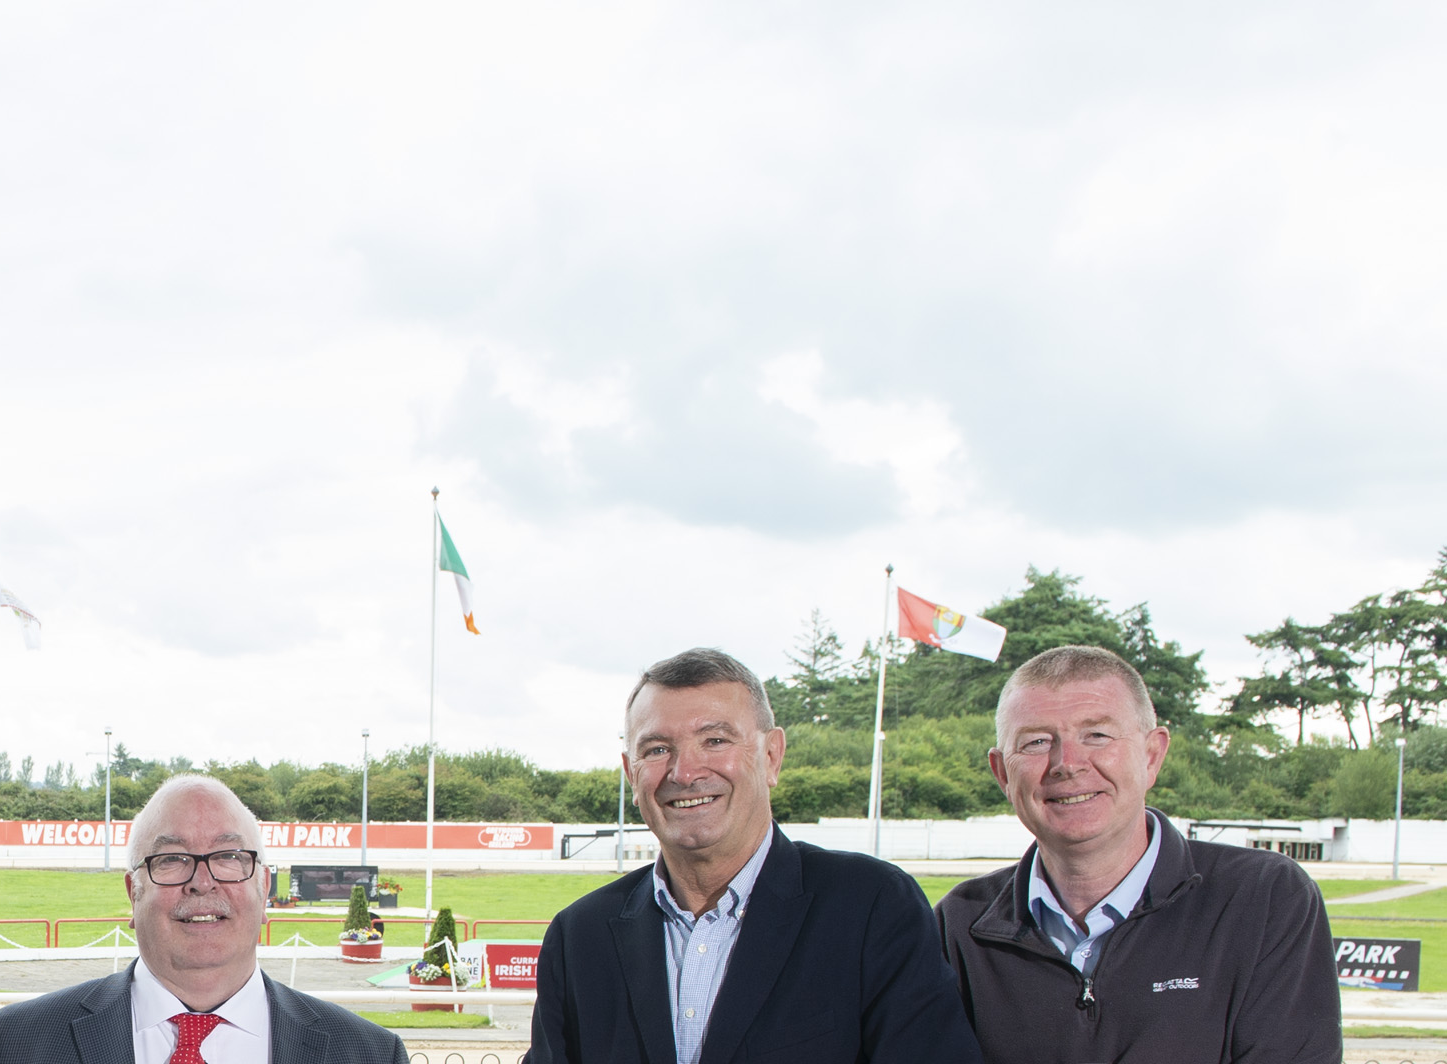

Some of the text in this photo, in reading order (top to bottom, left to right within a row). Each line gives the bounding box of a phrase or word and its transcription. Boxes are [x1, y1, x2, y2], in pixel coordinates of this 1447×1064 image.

[21, 823, 127, 845] WELCOME
[293, 825, 353, 847] PARK
[510, 956, 538, 965] CURRA
[1335, 941, 1402, 964] PARK
[495, 964, 532, 976] IRISH
